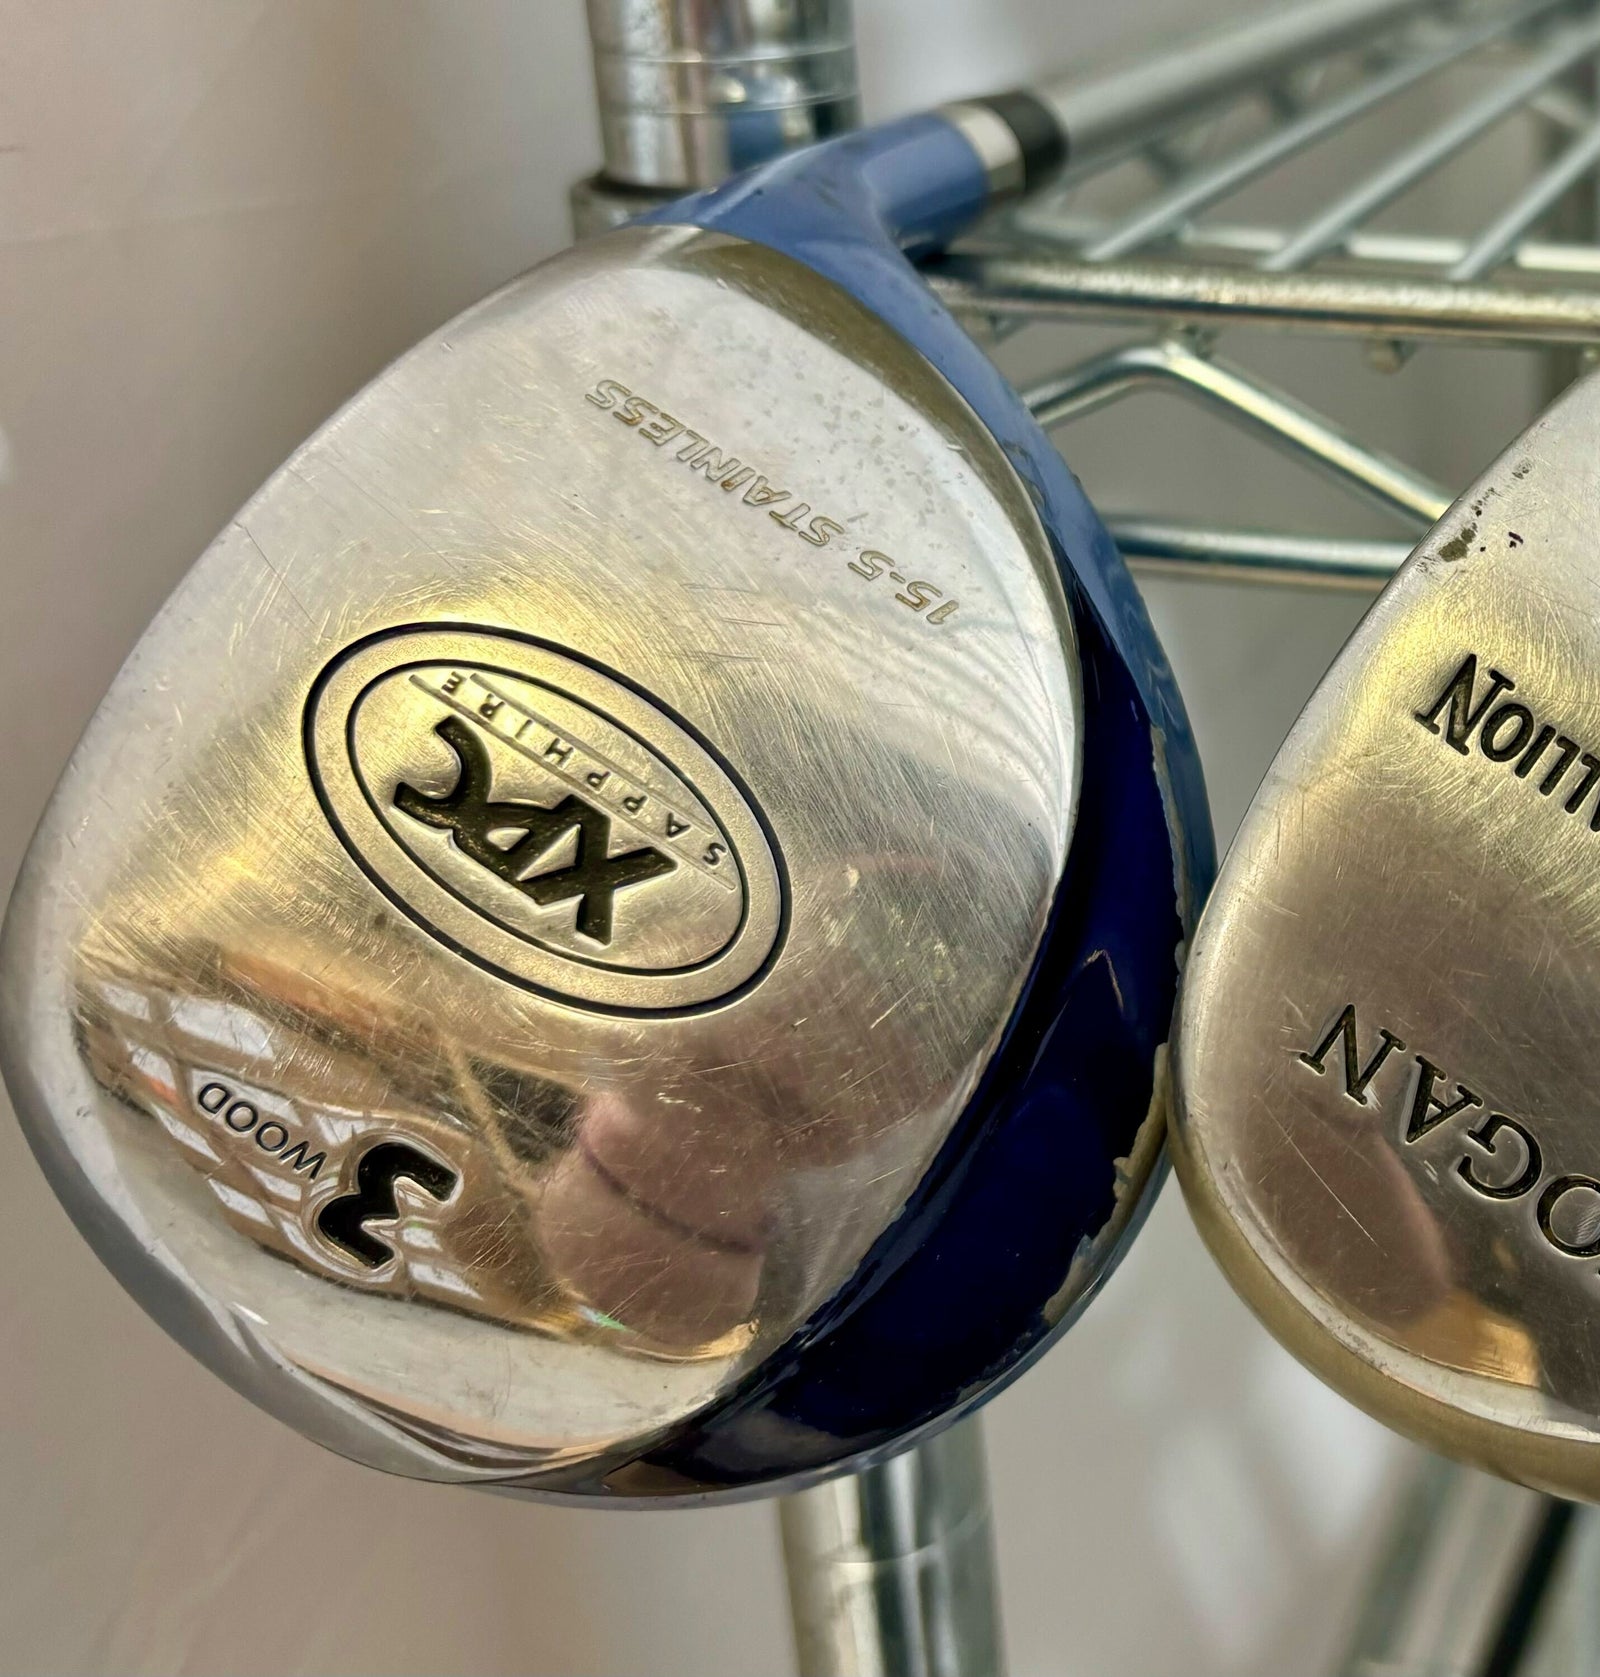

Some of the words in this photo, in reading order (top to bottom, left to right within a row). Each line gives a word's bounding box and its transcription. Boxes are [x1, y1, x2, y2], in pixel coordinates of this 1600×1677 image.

[583, 375, 843, 548] STAINLESS
[391, 716, 676, 946] XPC
[437, 669, 728, 868] SAPPHIRE
[190, 1080, 329, 1181] WOOD
[315, 1138, 454, 1269] 3
